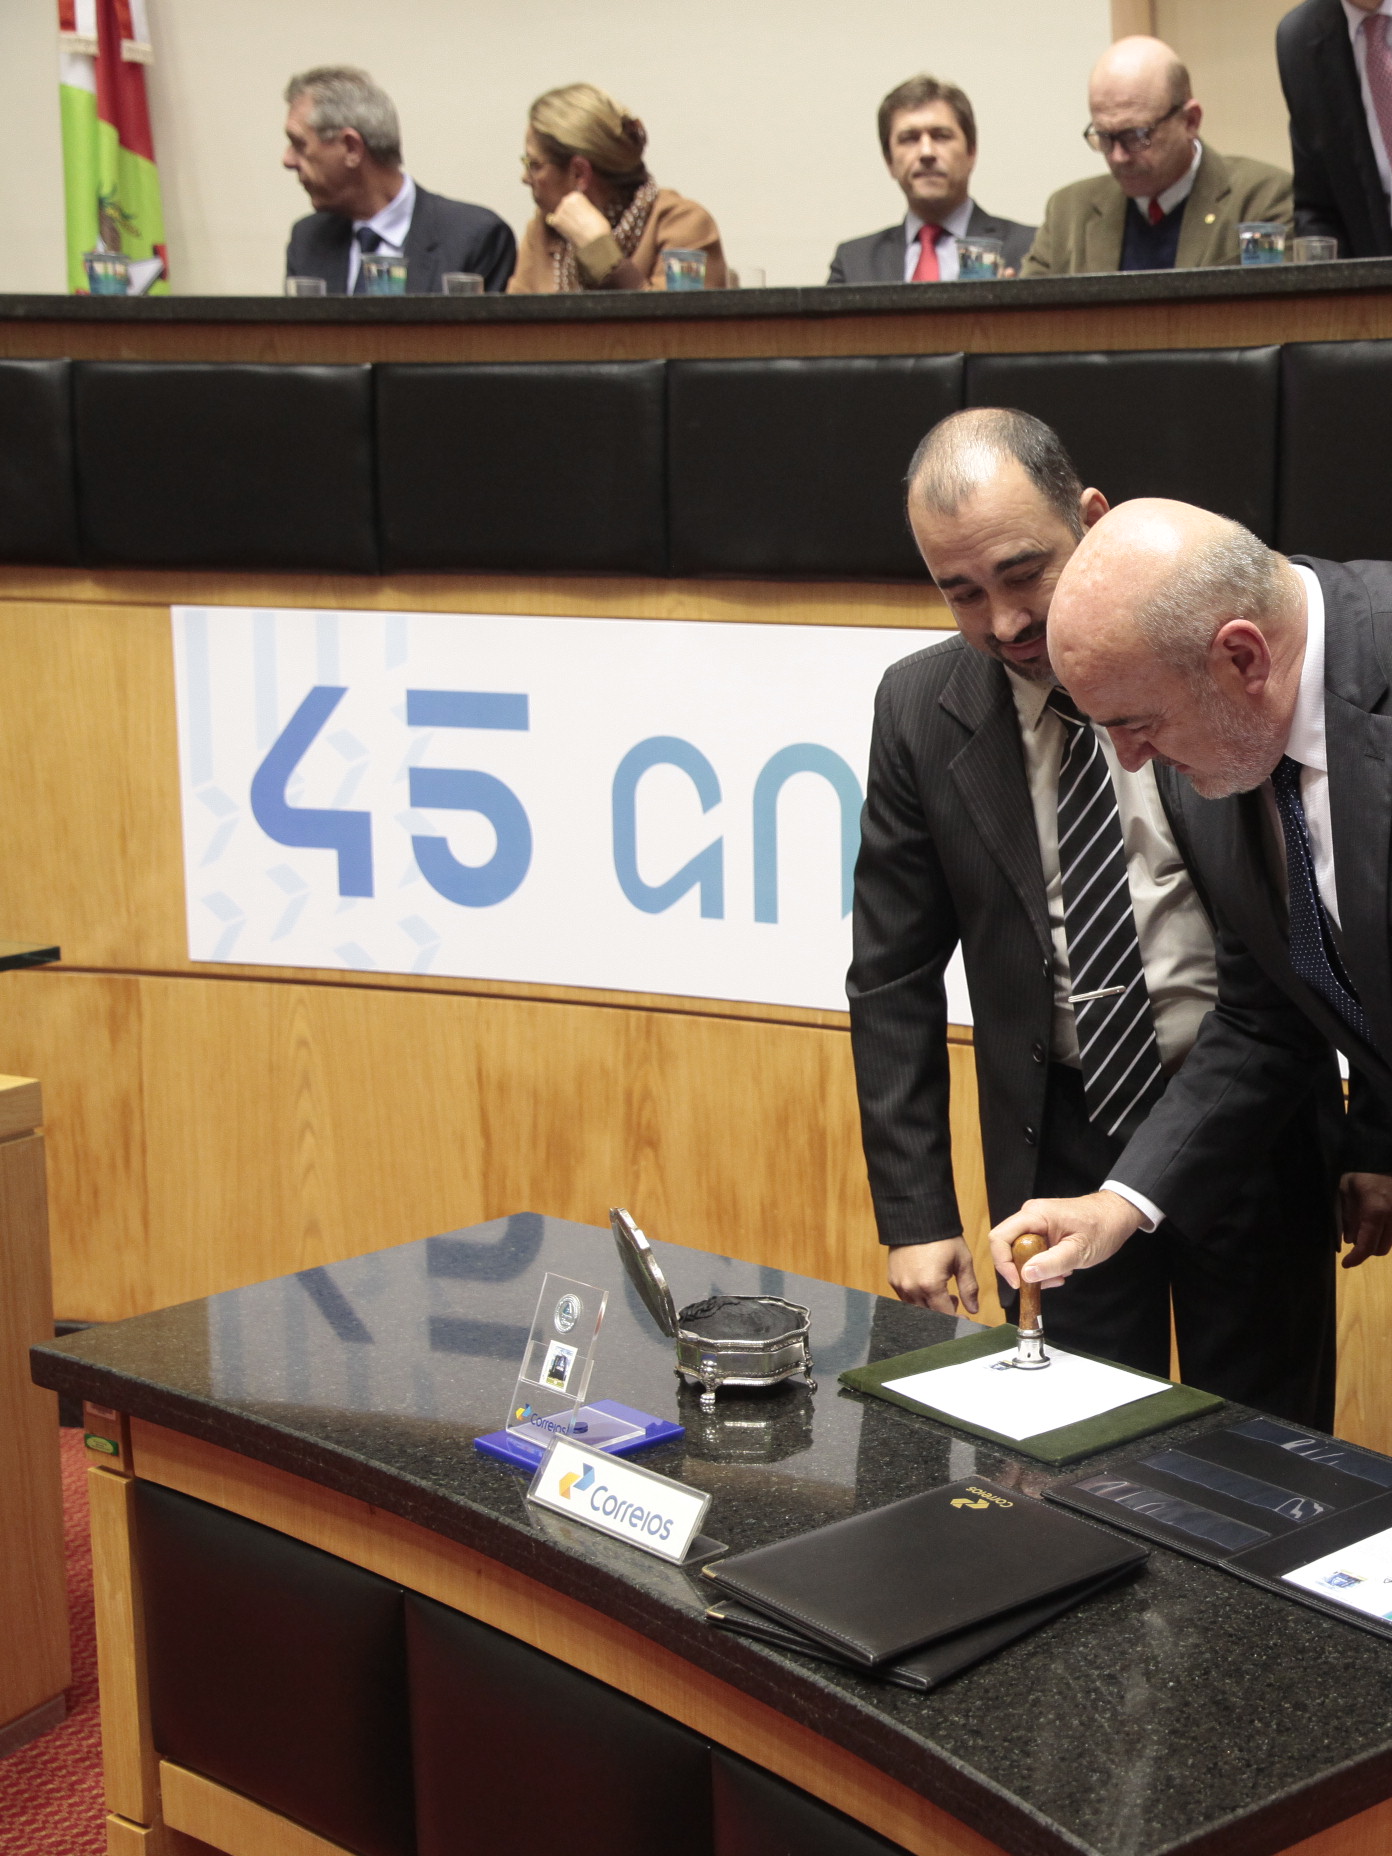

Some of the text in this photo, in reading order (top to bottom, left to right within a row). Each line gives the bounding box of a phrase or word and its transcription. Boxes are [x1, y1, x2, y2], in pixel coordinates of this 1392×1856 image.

[250, 685, 867, 925] 45 an
[590, 1485, 674, 1541] Correios
[965, 1486, 1014, 1508] Correios
